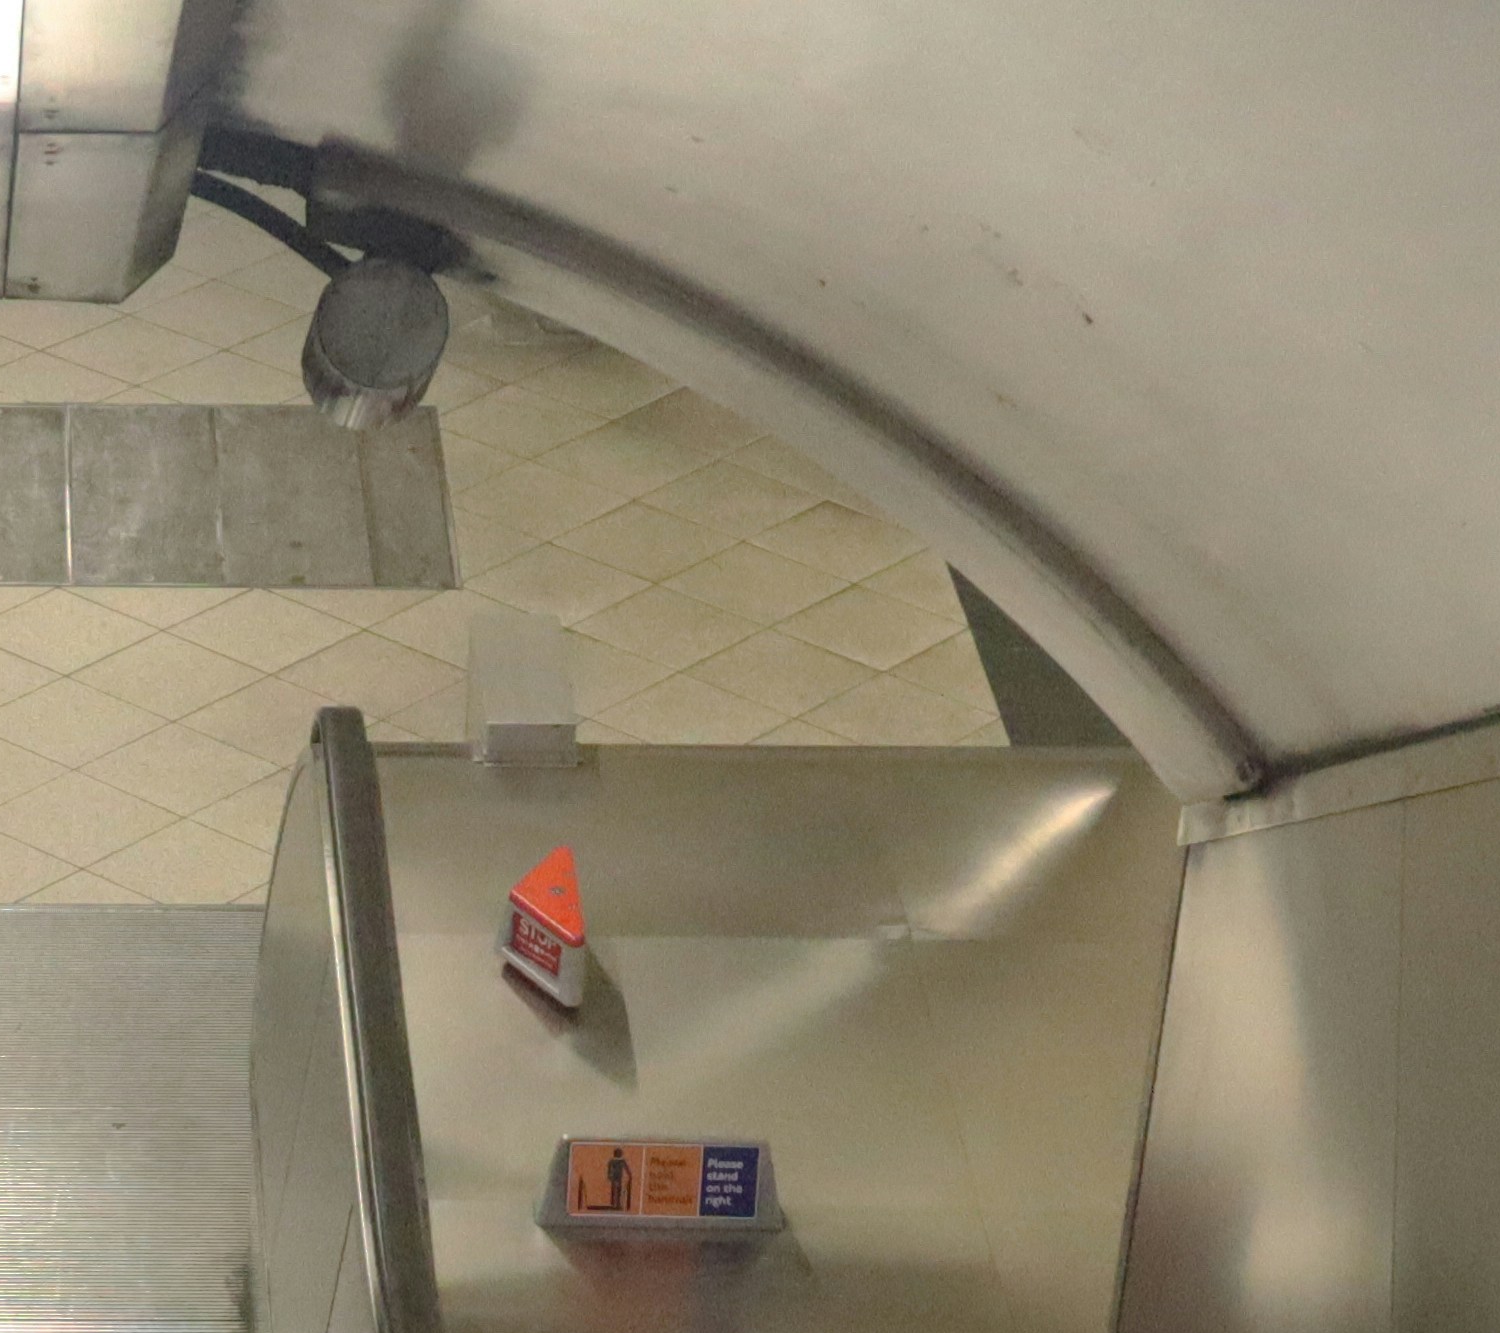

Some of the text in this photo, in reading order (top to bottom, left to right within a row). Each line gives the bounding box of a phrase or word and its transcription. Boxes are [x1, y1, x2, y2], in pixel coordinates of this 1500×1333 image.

[707, 1157, 744, 1169] Please
[706, 1170, 739, 1181] stand
[706, 1183, 743, 1193] on the
